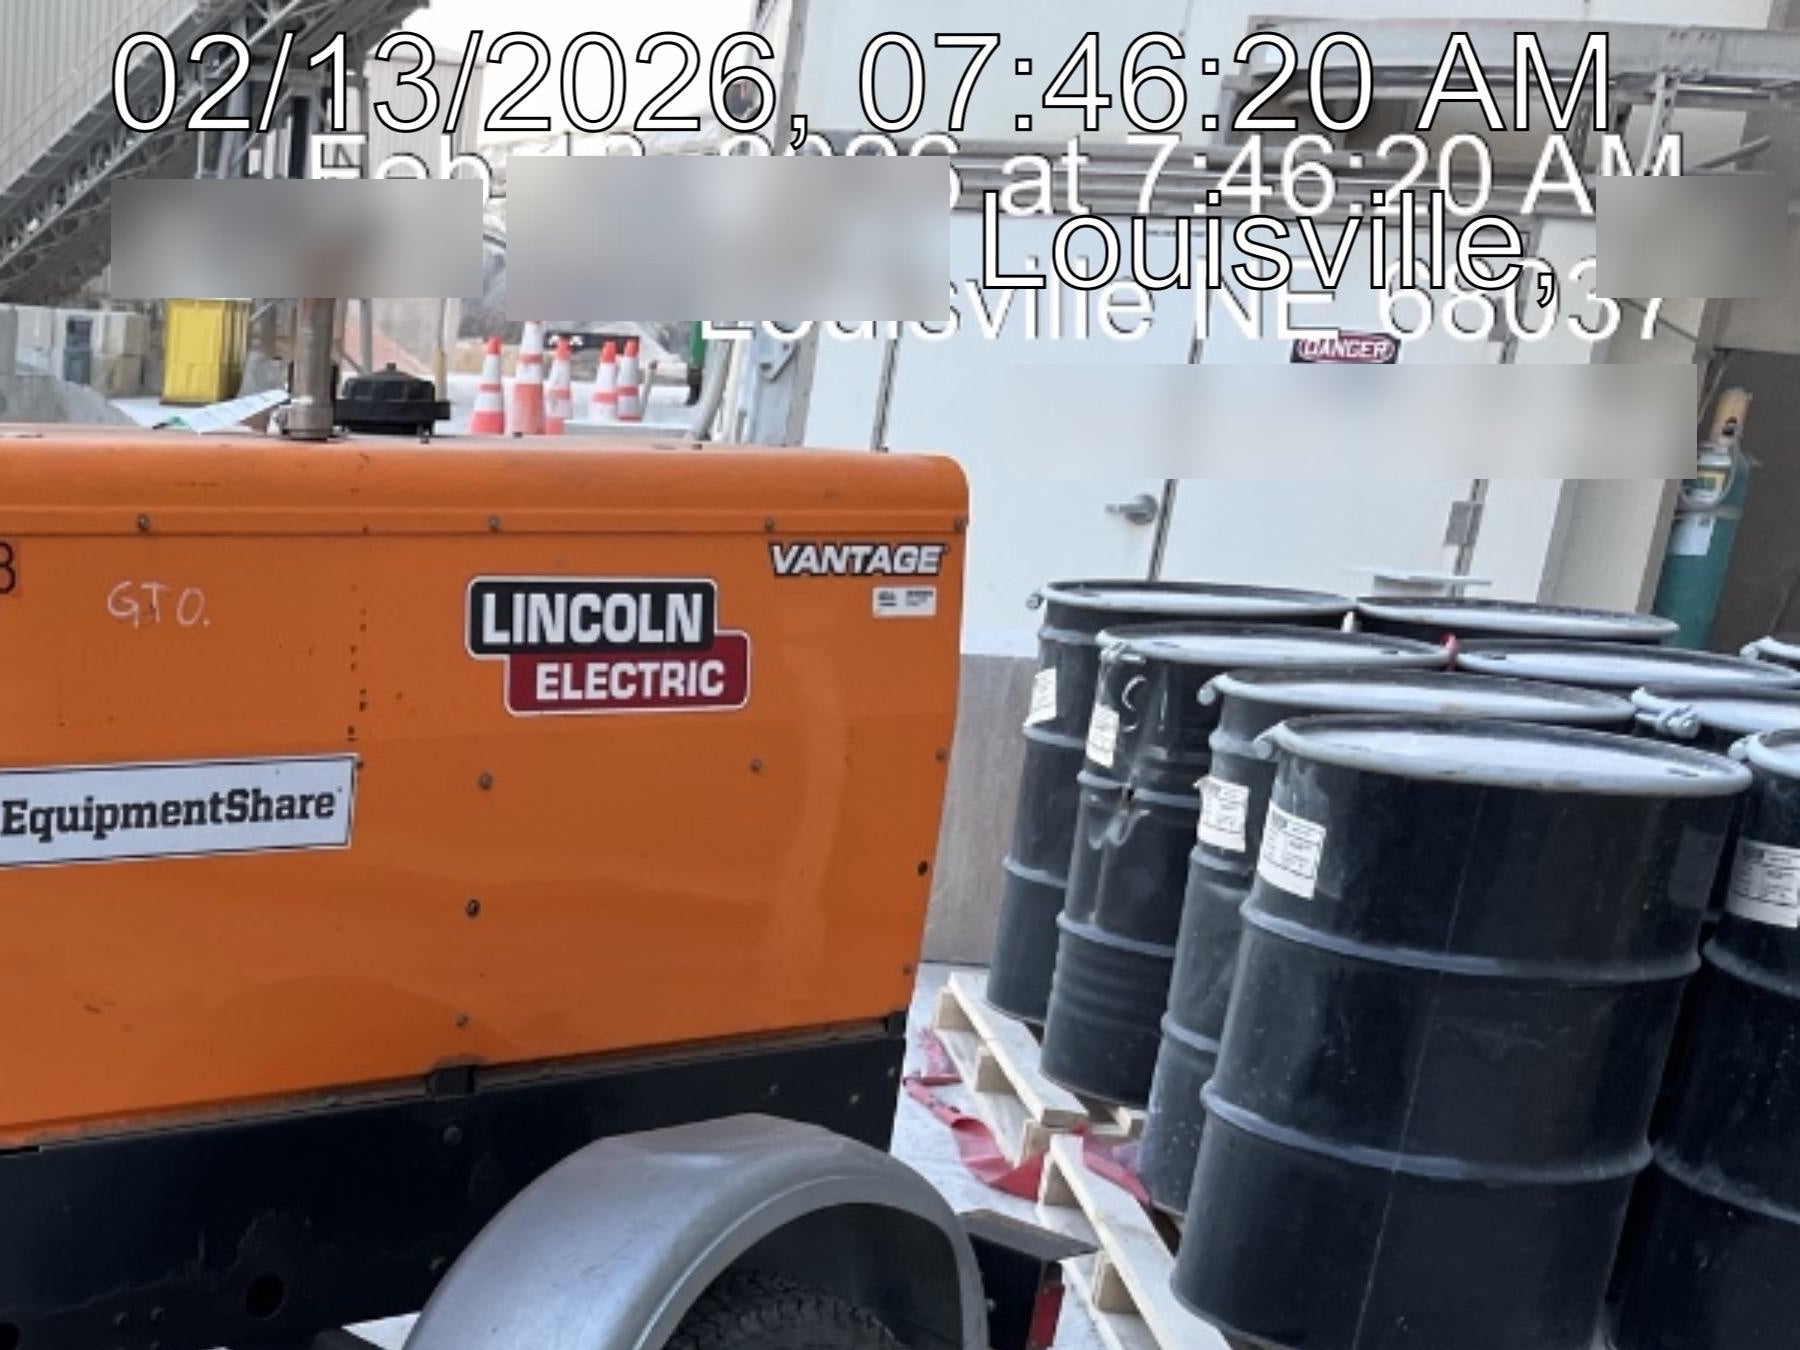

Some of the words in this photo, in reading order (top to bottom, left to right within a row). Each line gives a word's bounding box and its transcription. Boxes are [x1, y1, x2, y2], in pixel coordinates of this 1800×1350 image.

[771, 544, 945, 575] VANTAGE
[482, 592, 703, 645] LINCOLN
[536, 659, 726, 701] ELECTRIC
[0, 788, 337, 843] EquipmentShare
